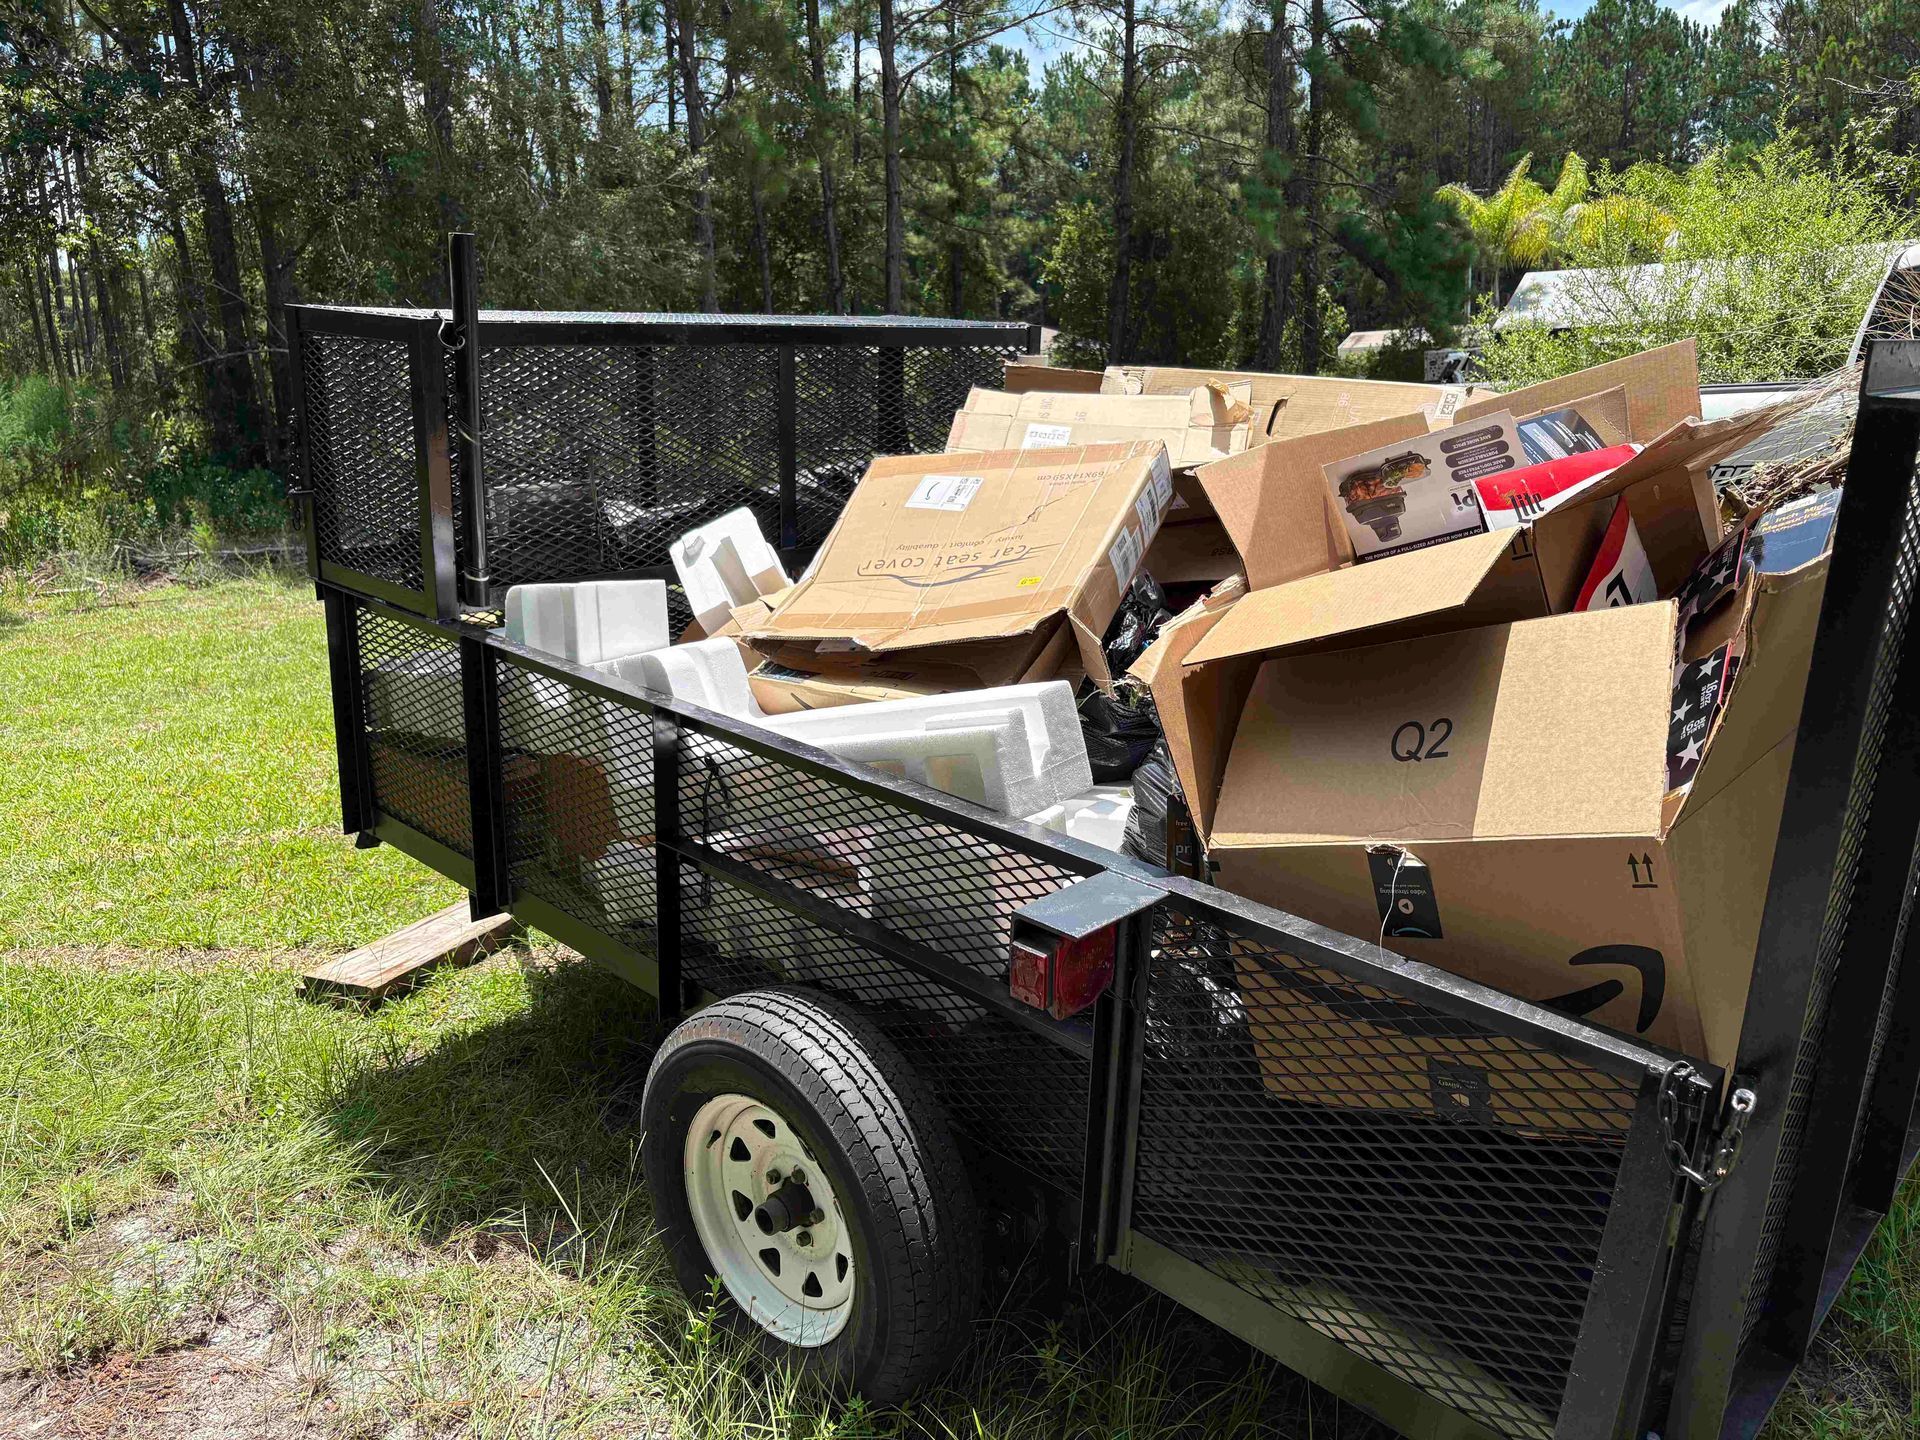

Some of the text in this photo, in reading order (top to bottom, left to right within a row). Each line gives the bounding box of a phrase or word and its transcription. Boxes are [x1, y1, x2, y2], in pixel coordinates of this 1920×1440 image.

[896, 543, 940, 552] durability
[949, 540, 985, 549] comfort
[995, 534, 1024, 544] luxury
[1374, 551, 1390, 560] POWER
[1400, 542, 1427, 553] FULL-SIZED
[1435, 535, 1451, 545] FRYER
[1450, 532, 1463, 540] NOW
[862, 545, 1028, 571] car seat cover
[1391, 717, 1453, 763] Q2
